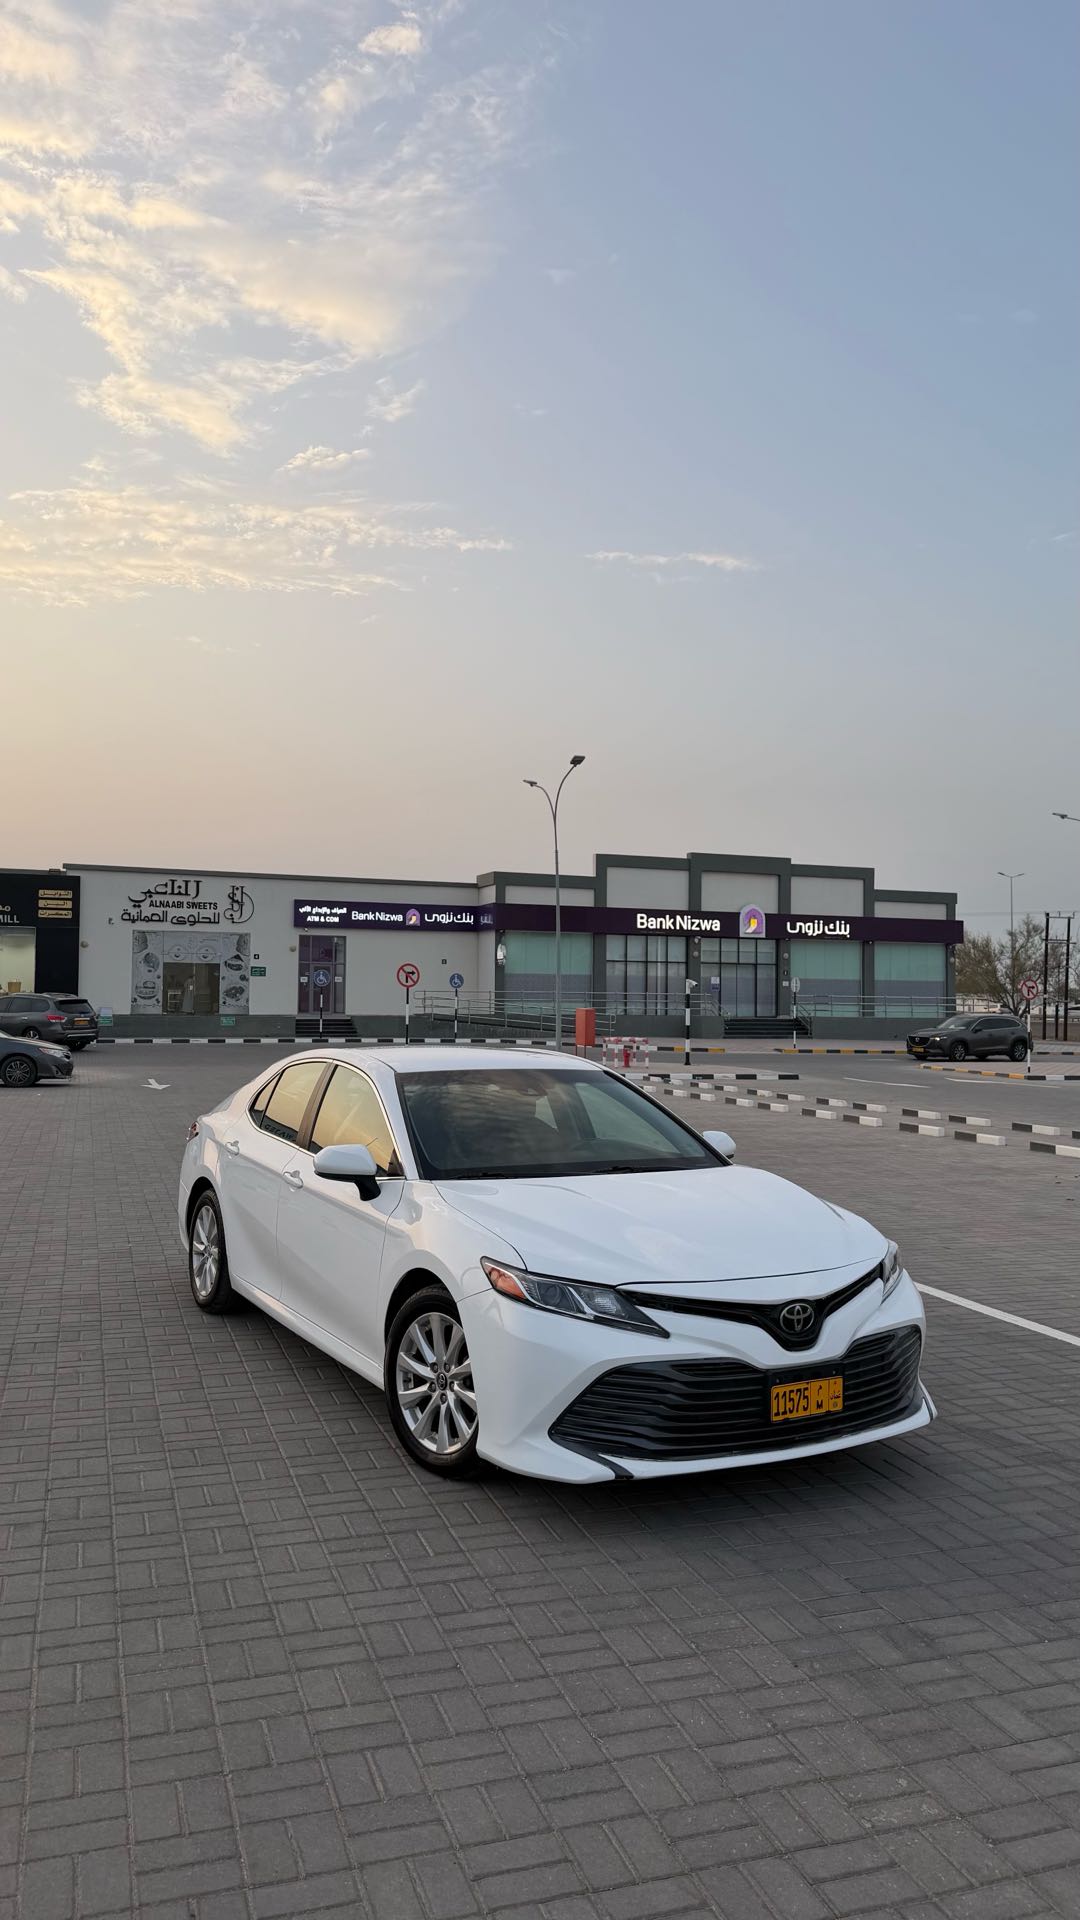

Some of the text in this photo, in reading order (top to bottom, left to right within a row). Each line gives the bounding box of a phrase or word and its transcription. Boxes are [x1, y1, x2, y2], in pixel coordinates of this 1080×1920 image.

[149, 900, 218, 911] ALNAABI SWEETS
[121, 908, 168, 924] العمانية
[351, 911, 403, 922] Bank Nizwa
[424, 912, 453, 924] نزوى
[454, 913, 474, 925] بنك
[636, 913, 721, 932] Bank Nizwa
[786, 921, 850, 938] بنك نزوى
[774, 1386, 809, 1417] 11575
[816, 1399, 824, 1410] M
